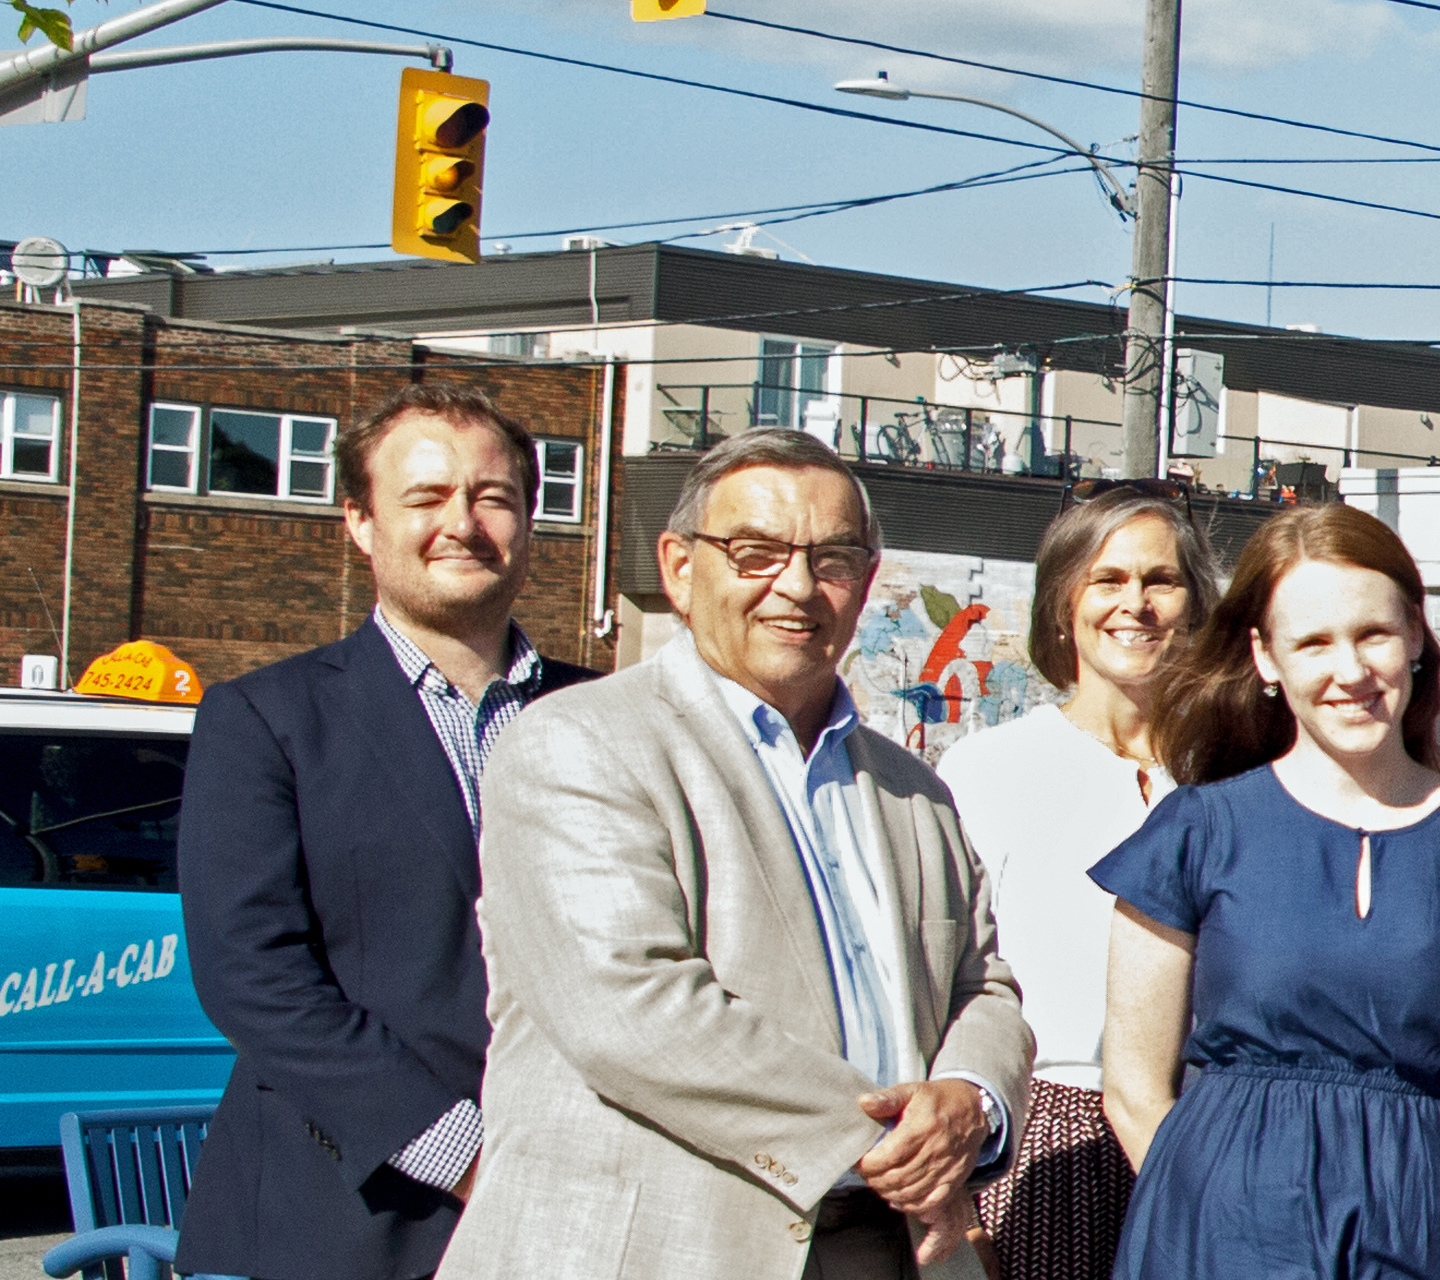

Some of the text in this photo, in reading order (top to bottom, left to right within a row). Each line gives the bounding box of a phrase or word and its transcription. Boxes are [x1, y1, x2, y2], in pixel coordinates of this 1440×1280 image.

[82, 671, 154, 692] 745-2424
[174, 670, 191, 692] 2
[0, 933, 178, 1017] CALL-A-CAB
